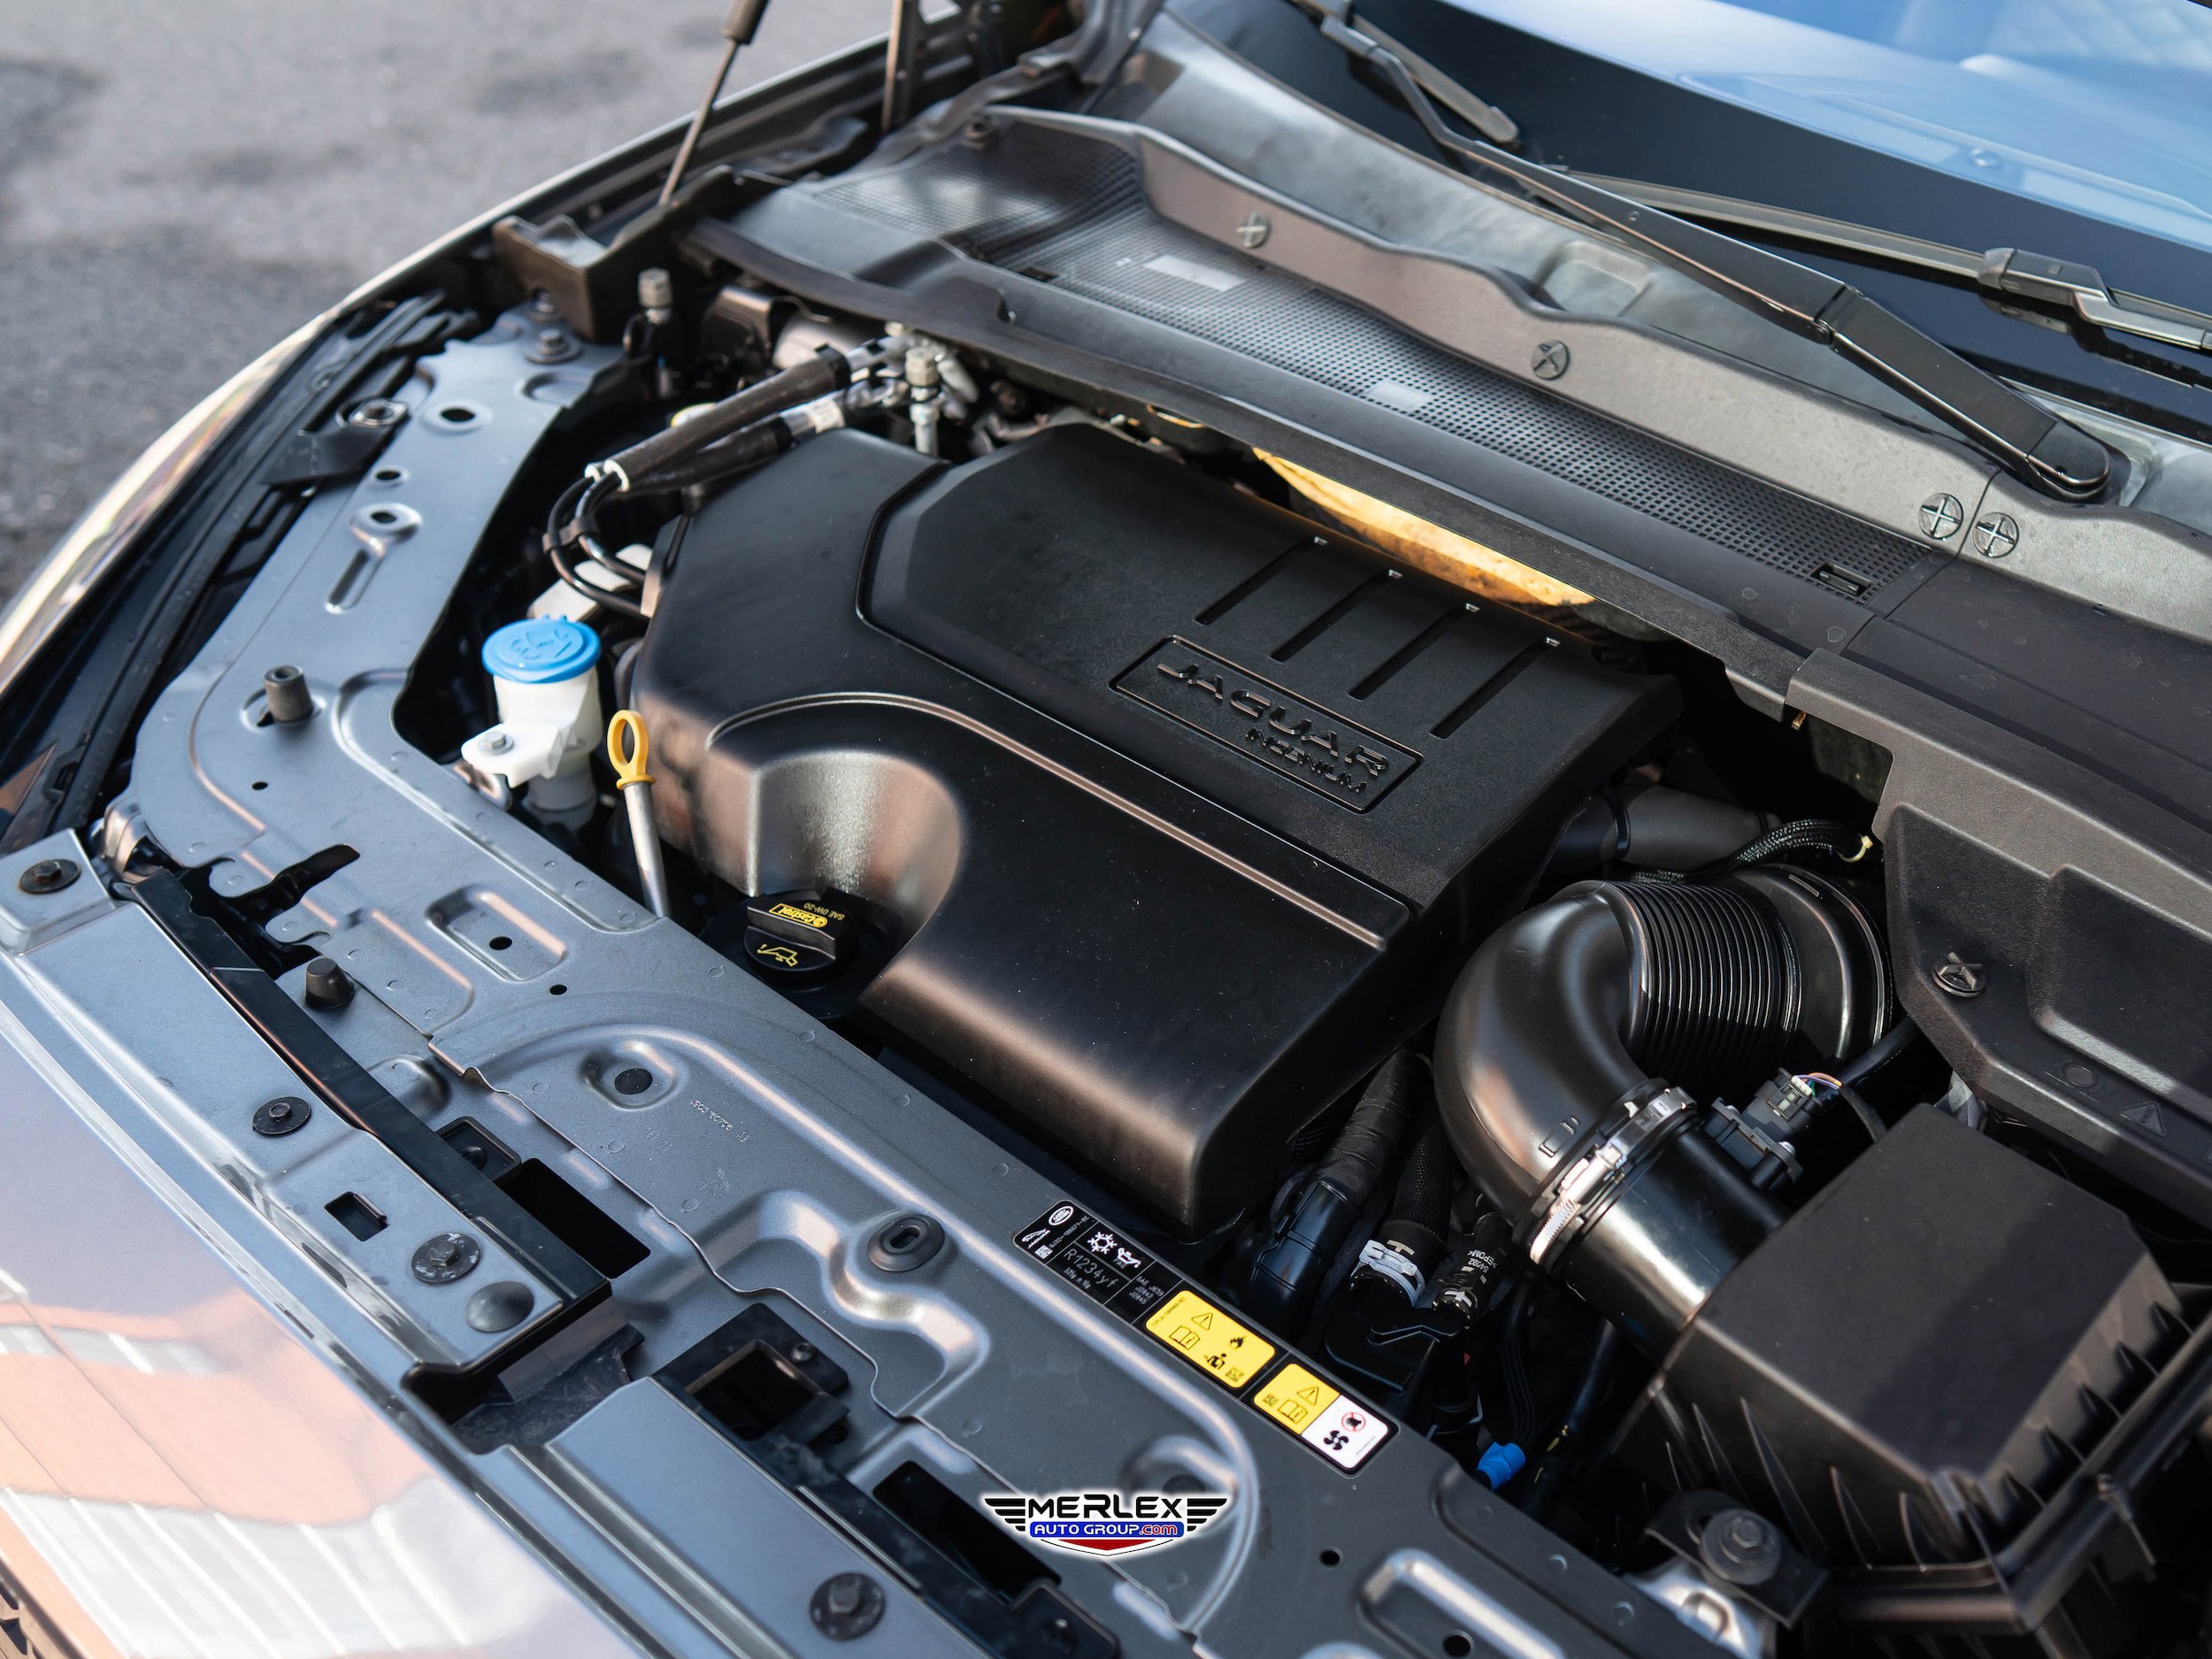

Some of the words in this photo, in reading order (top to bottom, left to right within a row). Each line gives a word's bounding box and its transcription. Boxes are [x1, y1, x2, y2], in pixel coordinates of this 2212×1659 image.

[1157, 664, 1389, 777] JAGUAR
[1245, 726, 1367, 794] INGENIUM
[778, 906, 816, 923] Castrol
[803, 902, 829, 916] 0W-20
[828, 910, 845, 921] SAE
[1064, 1248, 1119, 1288] R1234yf
